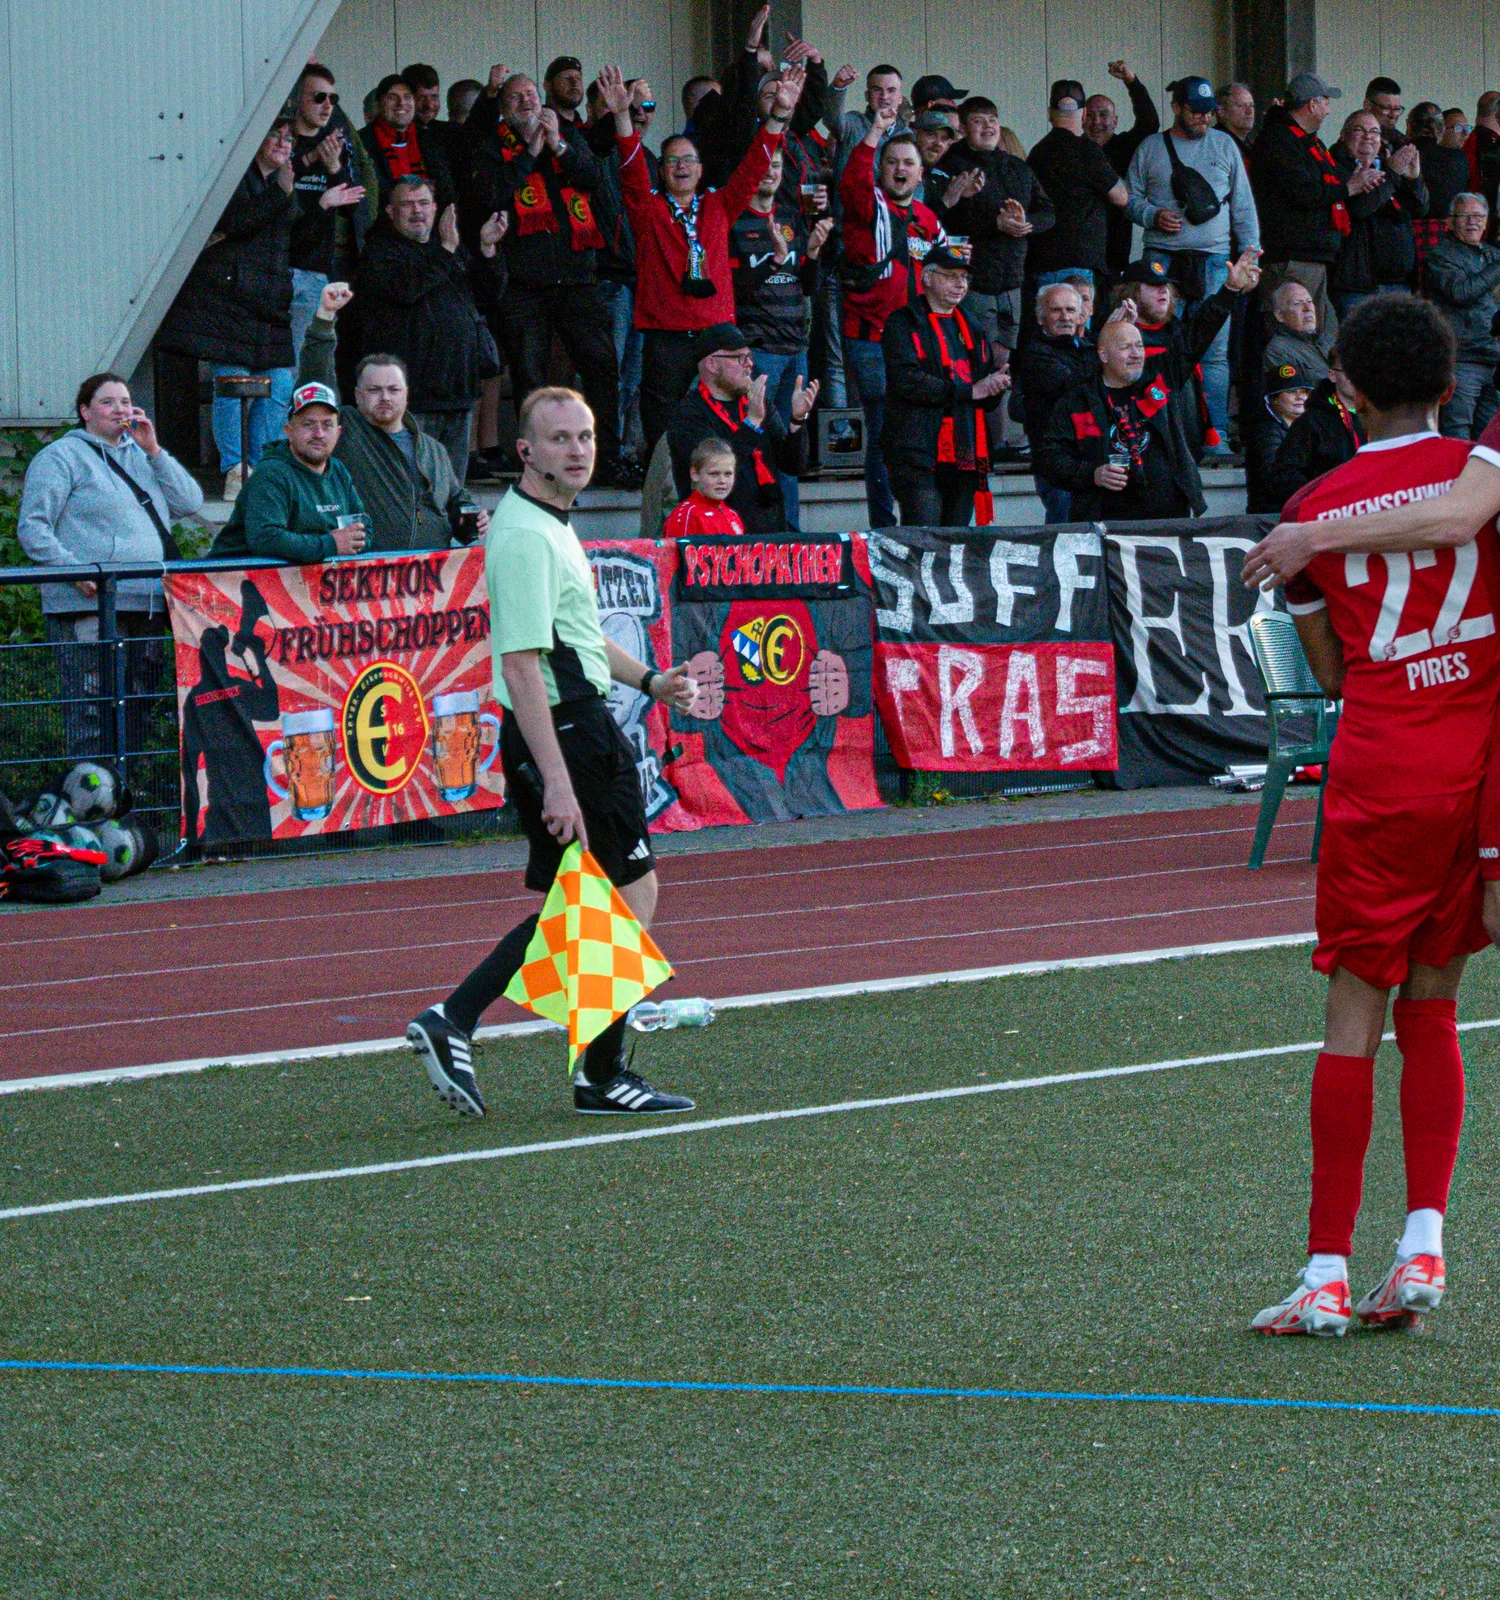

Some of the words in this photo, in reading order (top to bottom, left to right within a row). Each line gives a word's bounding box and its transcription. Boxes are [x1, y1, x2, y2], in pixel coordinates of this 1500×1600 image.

[319, 558, 445, 606] SEKTION
[685, 542, 842, 587] PSYCHOPATHEN
[868, 531, 1102, 633] SUFF
[1345, 540, 1496, 663] 22
[277, 602, 490, 665] FRÜHSCHOPPEN
[1406, 652, 1470, 691] PIRES
[392, 723, 405, 736] 16
